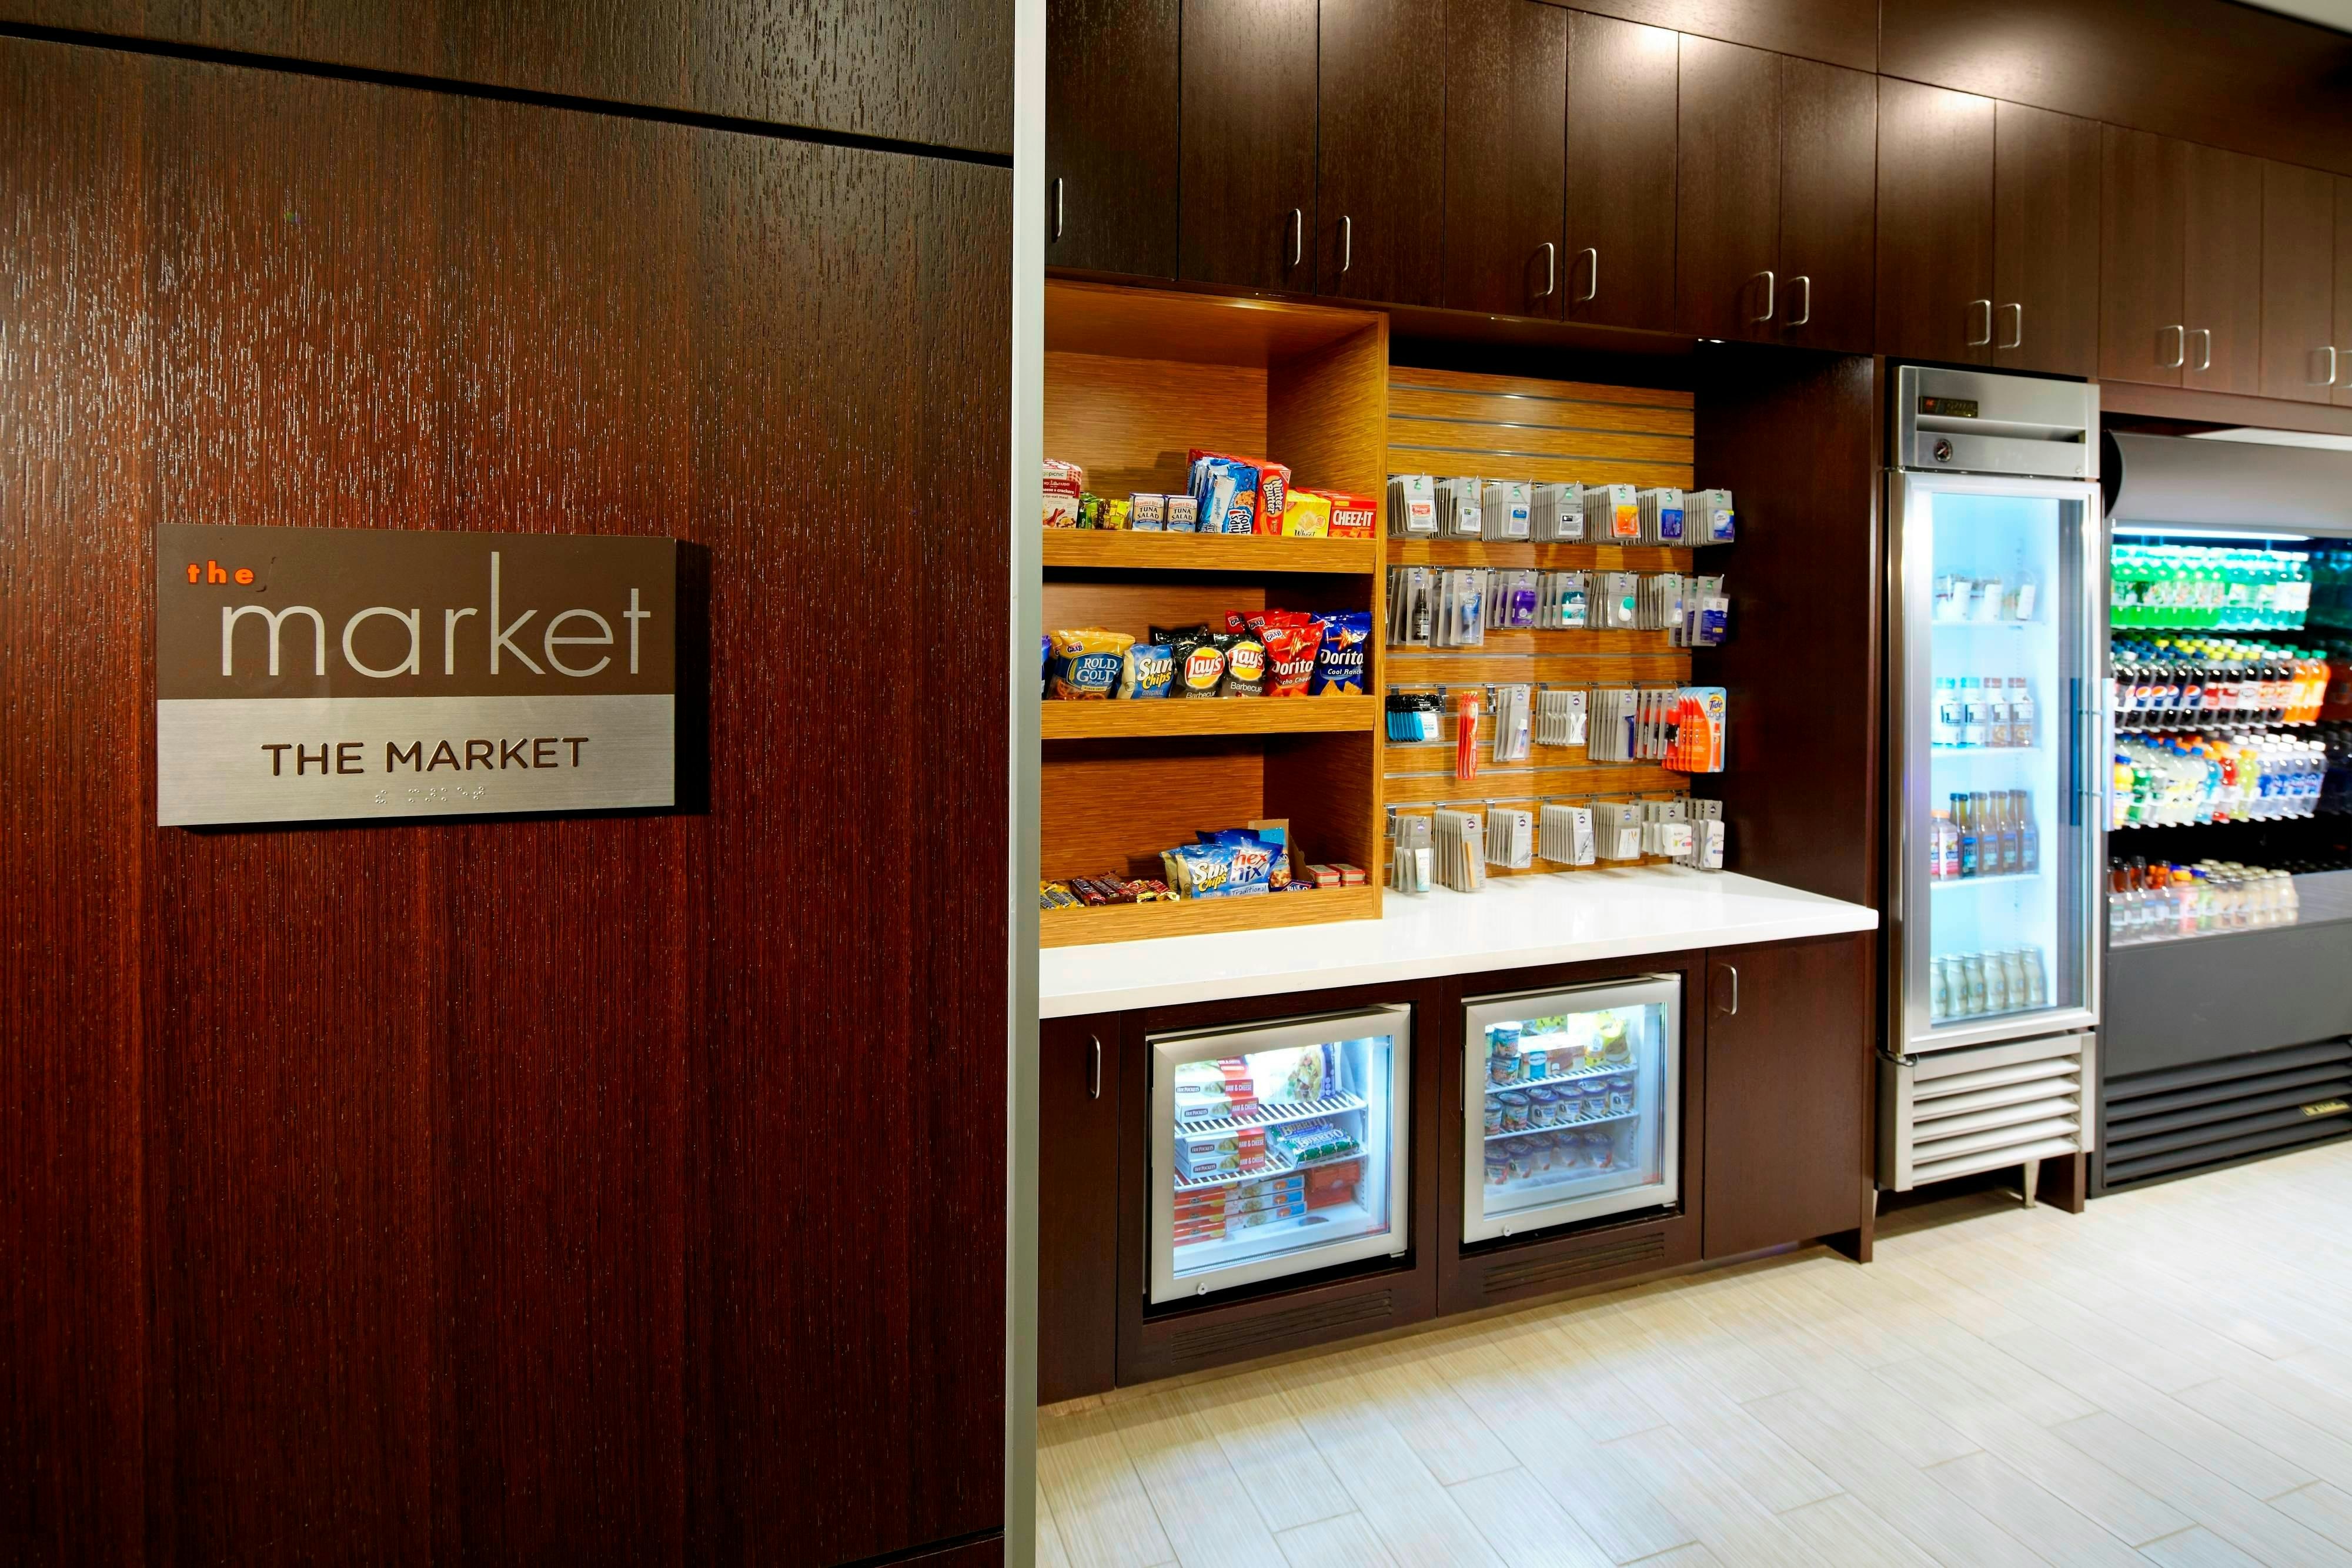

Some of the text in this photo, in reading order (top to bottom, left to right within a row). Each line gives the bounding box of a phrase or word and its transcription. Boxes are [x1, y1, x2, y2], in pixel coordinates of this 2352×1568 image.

[1263, 483, 1275, 514] Butter
[1272, 479, 1284, 511] Nutter
[1229, 516, 1240, 534] hips
[1333, 510, 1374, 527] CHEEZ-IT
[187, 561, 254, 586] the
[222, 551, 651, 678] market
[1250, 620, 1264, 629] GRAB
[1267, 631, 1282, 641] GRAB
[1083, 658, 1117, 670] ROLD
[1321, 648, 1364, 666] Dorito
[1137, 658, 1173, 681] Sun
[1272, 657, 1314, 676] Dorito
[1076, 669, 1116, 683] GOLD
[1142, 671, 1171, 690] Chips
[1230, 681, 1262, 693] Barbecue
[1709, 700, 1723, 710] Tide
[261, 737, 589, 777] THE MARKET
[1235, 850, 1272, 866] hex
[1192, 862, 1228, 885] Sun
[1198, 872, 1227, 892] Chips
[1232, 885, 1267, 895] Traditional
[1280, 1118, 1327, 1135] BURRITO
[1295, 1129, 1344, 1148] BURRITO
